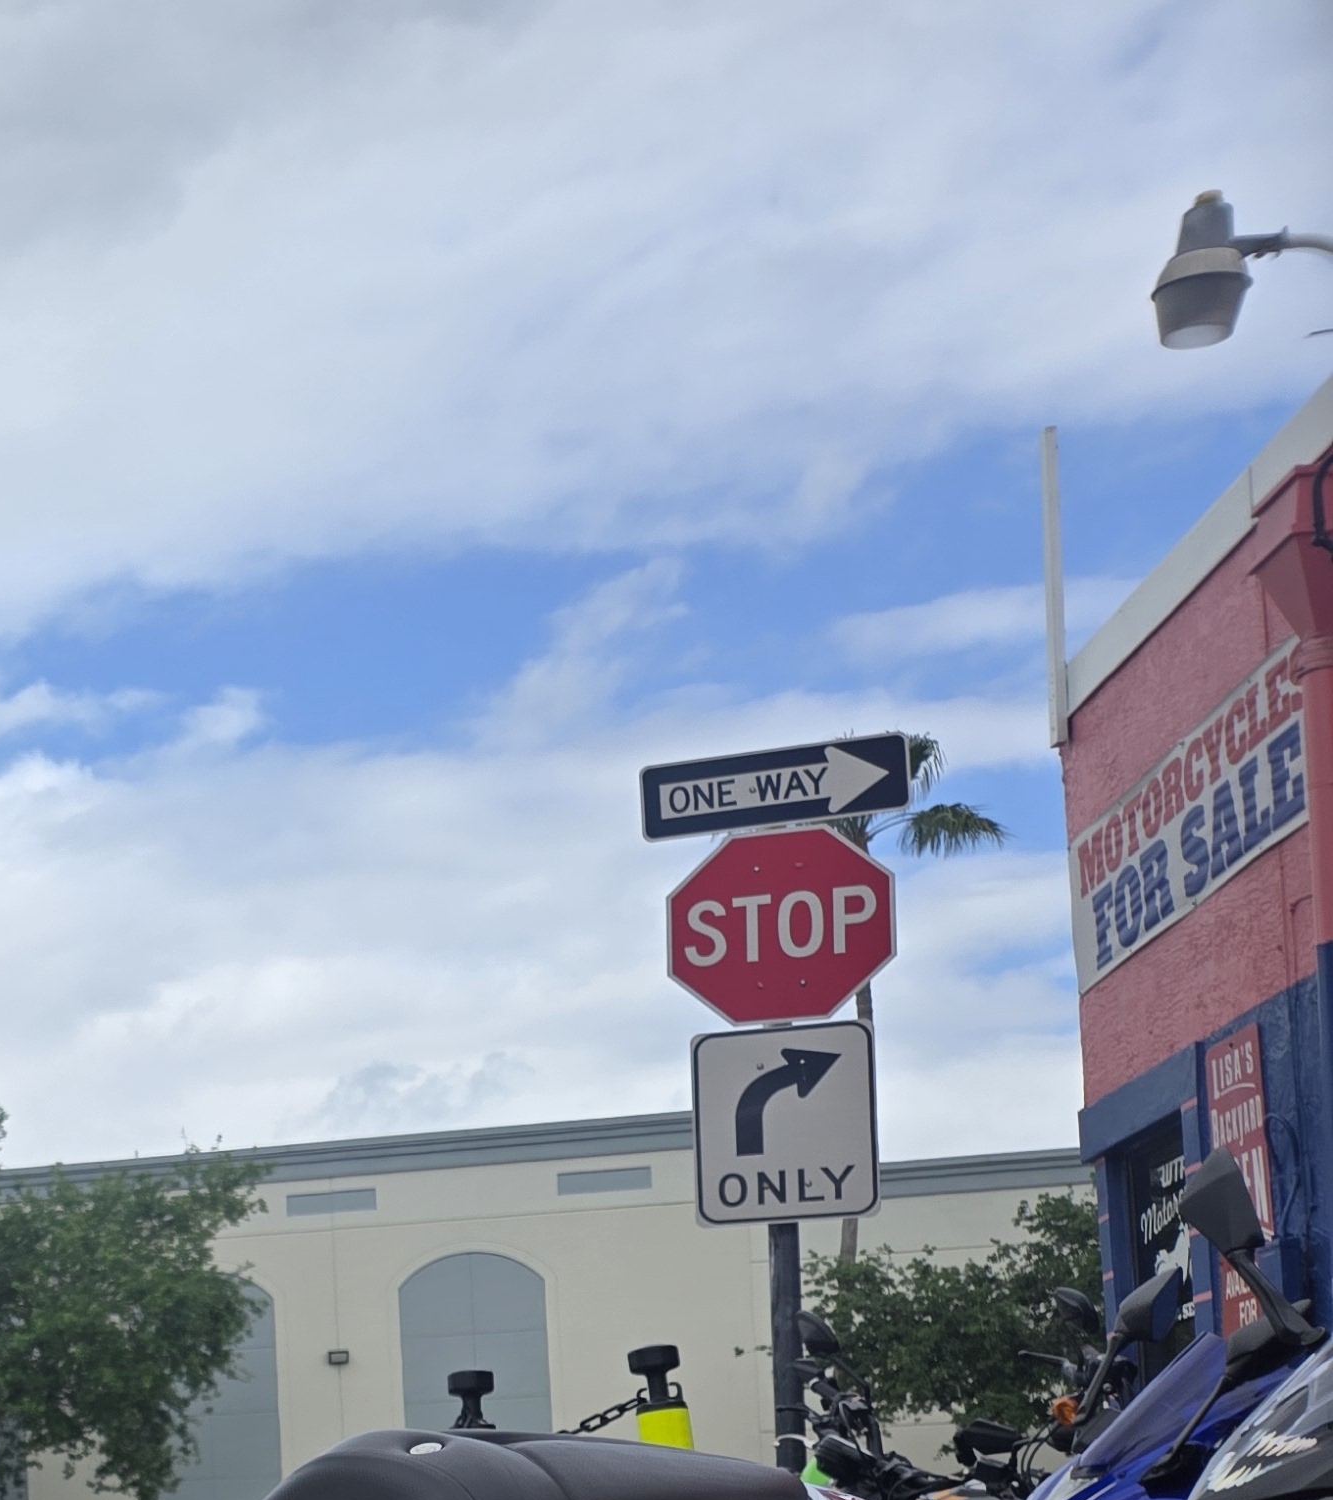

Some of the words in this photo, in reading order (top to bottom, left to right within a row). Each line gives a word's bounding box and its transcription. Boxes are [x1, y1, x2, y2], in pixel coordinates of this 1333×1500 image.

[668, 779, 737, 814] ONE
[754, 767, 828, 803] WAY
[1093, 840, 1175, 970] FOR
[1181, 721, 1303, 897] SALE
[684, 885, 877, 968] STOP
[1212, 1041, 1254, 1100] LISA'S
[718, 1165, 855, 1208] ONLY
[1238, 1298, 1258, 1328] FOR
